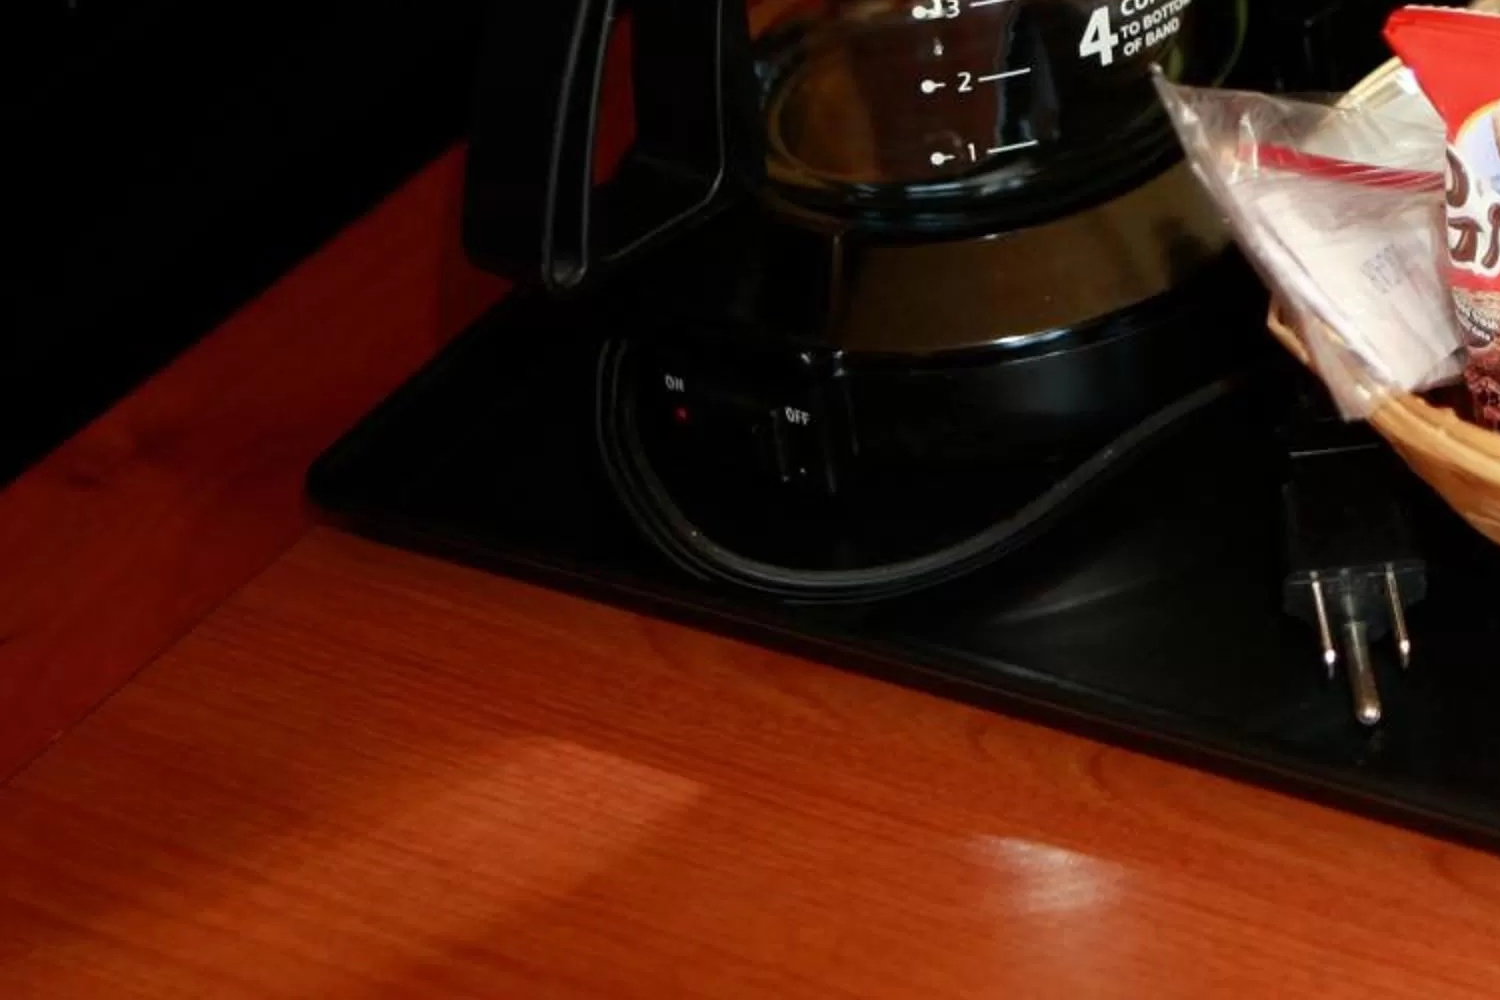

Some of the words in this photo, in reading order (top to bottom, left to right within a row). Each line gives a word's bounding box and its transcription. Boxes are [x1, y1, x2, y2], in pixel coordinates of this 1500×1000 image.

[1079, 5, 1119, 67] 4
[1120, 21, 1141, 39] TO
[1123, 37, 1143, 56] OF
[1145, 17, 1181, 47] BAND
[957, 71, 973, 93] 2
[967, 142, 977, 163] 1
[784, 406, 810, 426] OFF
